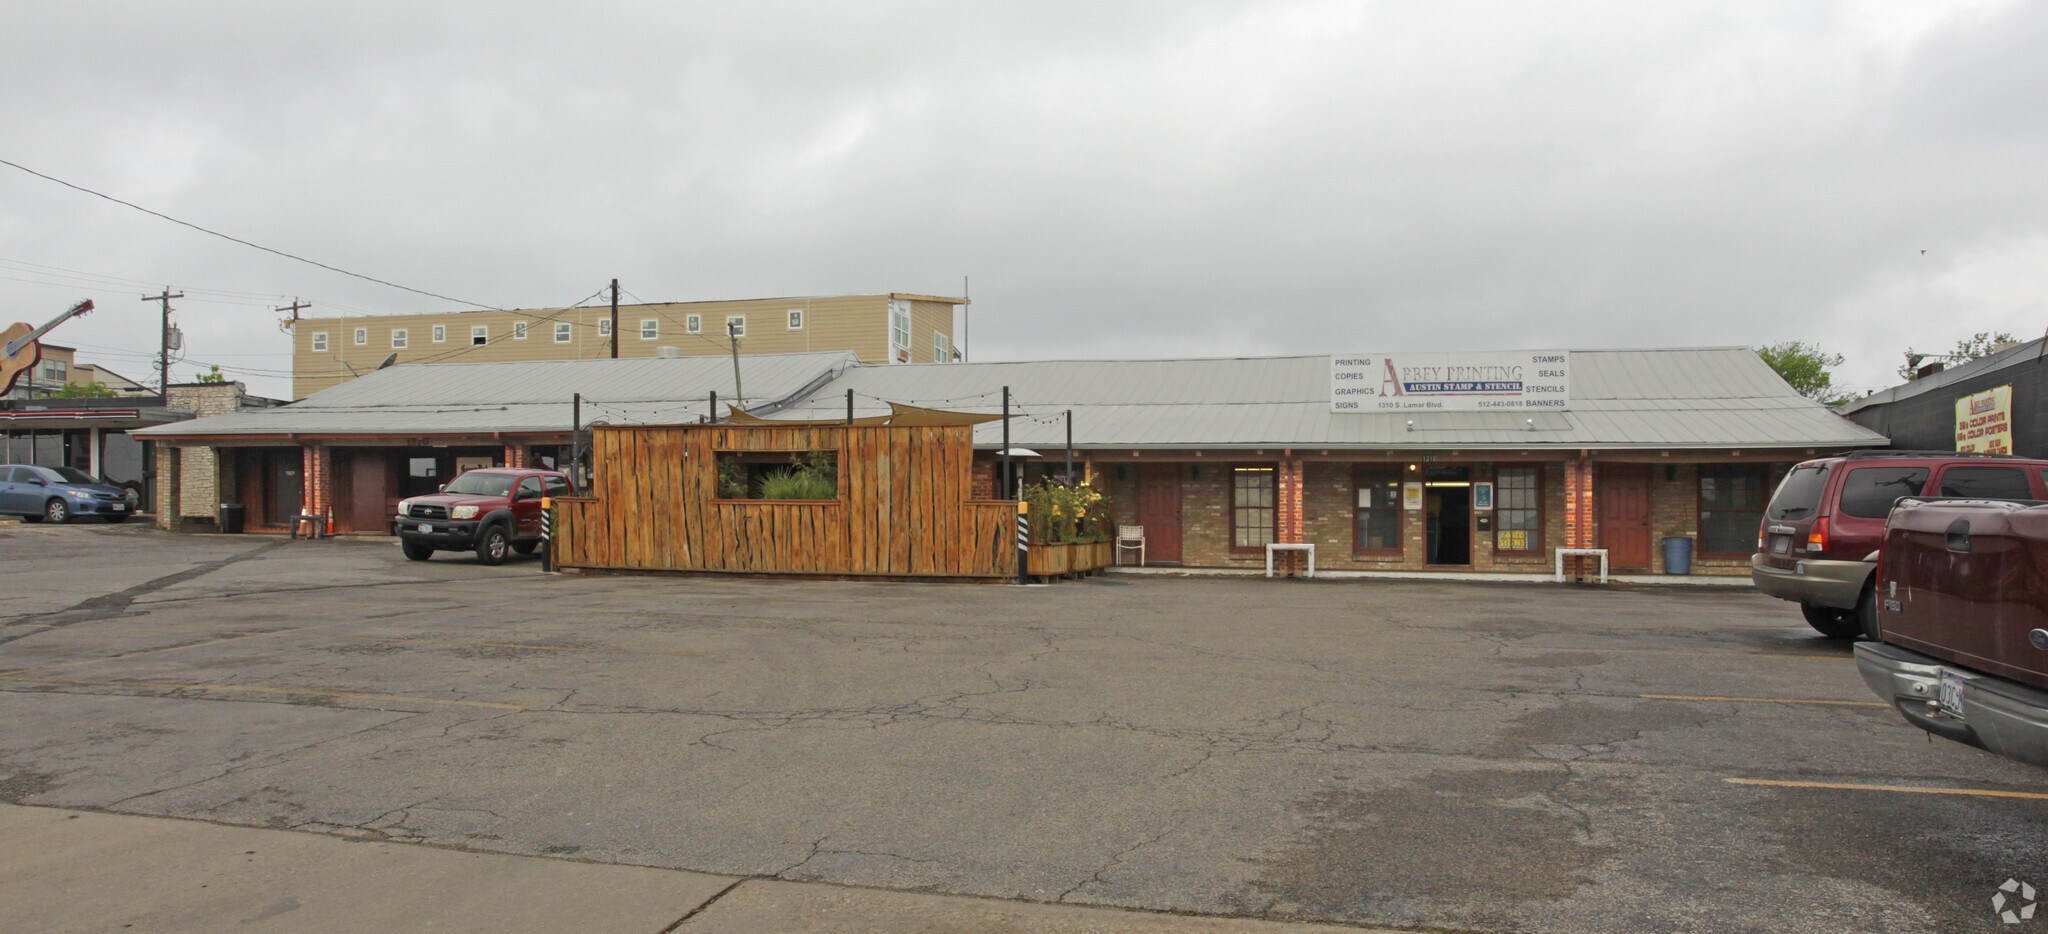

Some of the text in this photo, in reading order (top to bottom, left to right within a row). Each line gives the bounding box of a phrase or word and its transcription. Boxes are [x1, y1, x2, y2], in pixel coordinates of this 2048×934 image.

[1335, 358, 1371, 366] PRINTING
[1532, 355, 1565, 363] STAMPS
[1335, 372, 1364, 380] COPIES
[1446, 365, 1523, 381] PRINTING
[1409, 381, 1522, 392] AUSTIN STAMP & STENCIL
[1525, 385, 1565, 393] STENCILS
[1335, 387, 1375, 396] GRAPHICS
[1335, 401, 1359, 409] SIGNS
[1525, 399, 1565, 407] BANNERS
